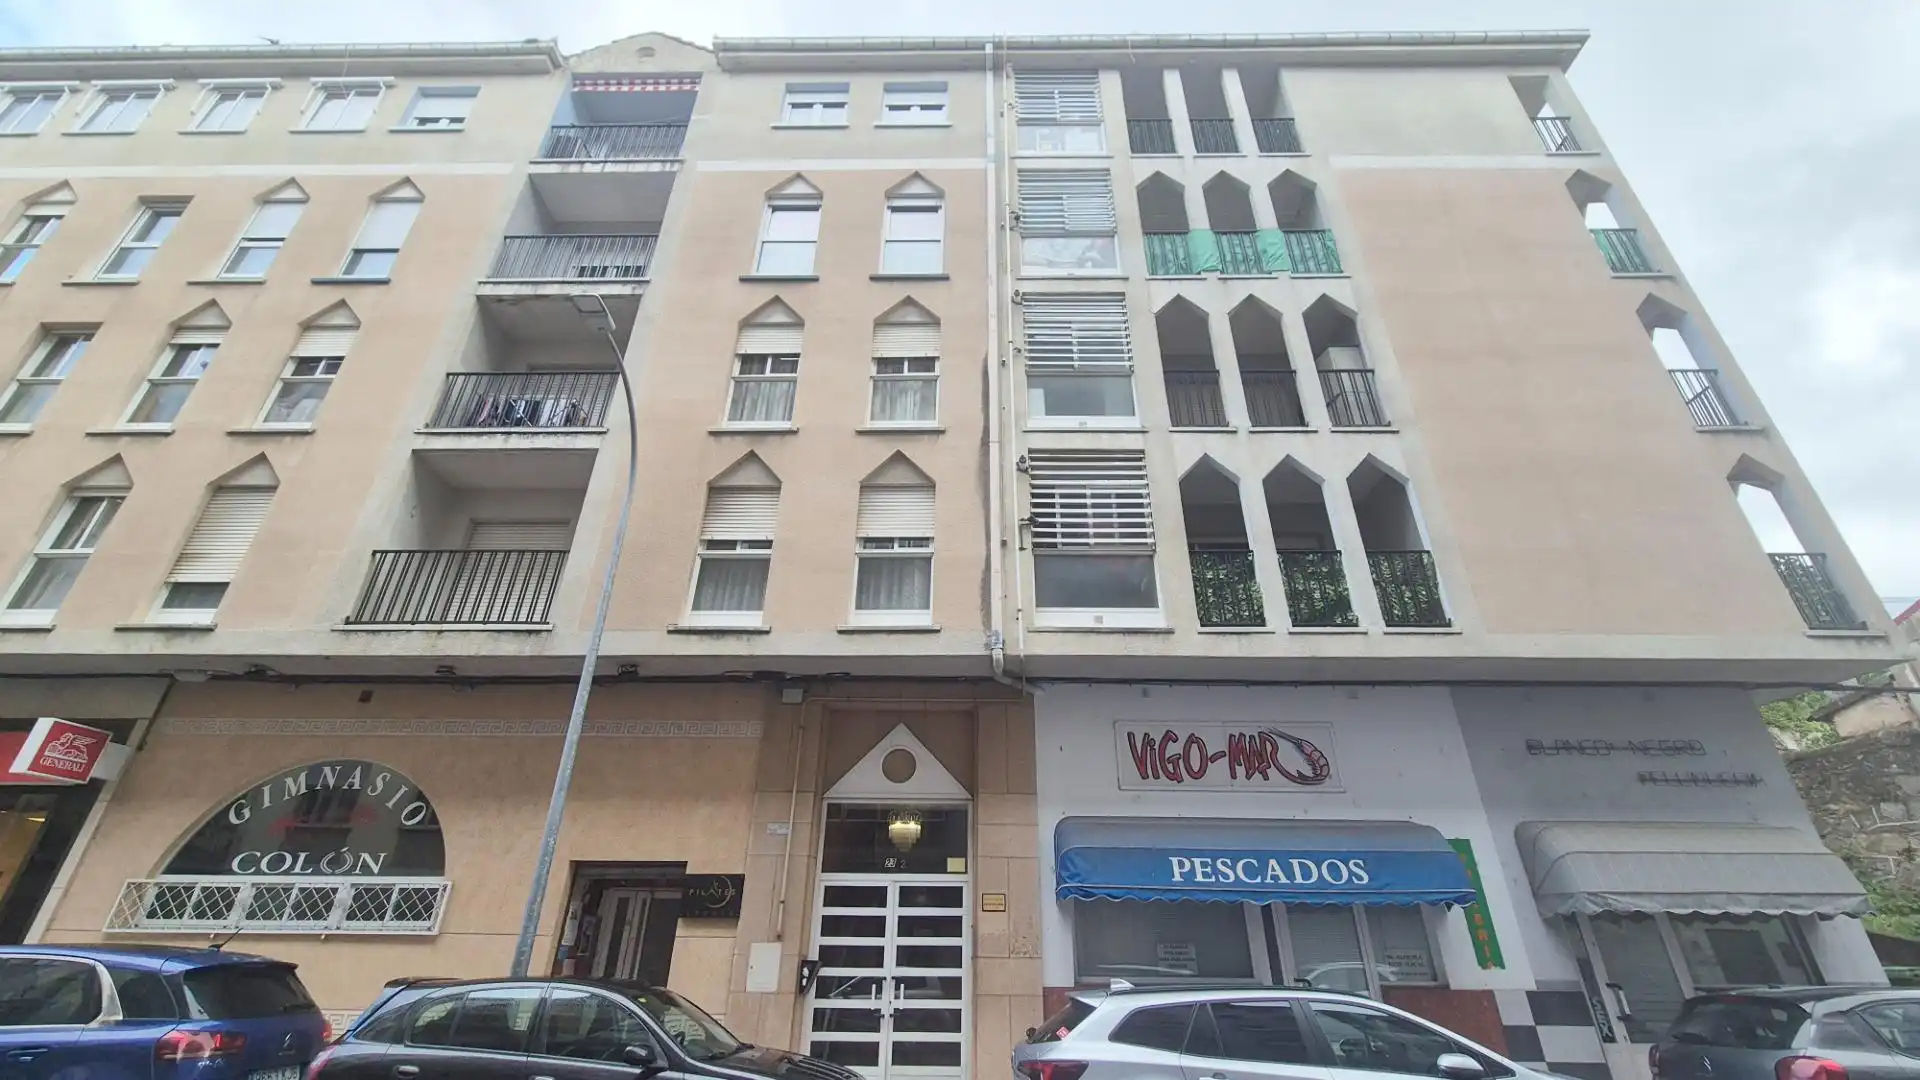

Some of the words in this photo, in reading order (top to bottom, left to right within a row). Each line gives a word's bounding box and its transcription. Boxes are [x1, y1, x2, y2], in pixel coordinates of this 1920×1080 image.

[39, 755, 86, 773] GENERALI
[227, 764, 428, 826] GIMNASIO
[230, 846, 388, 875] COLÓN
[1168, 856, 1370, 885] PESCADOS
